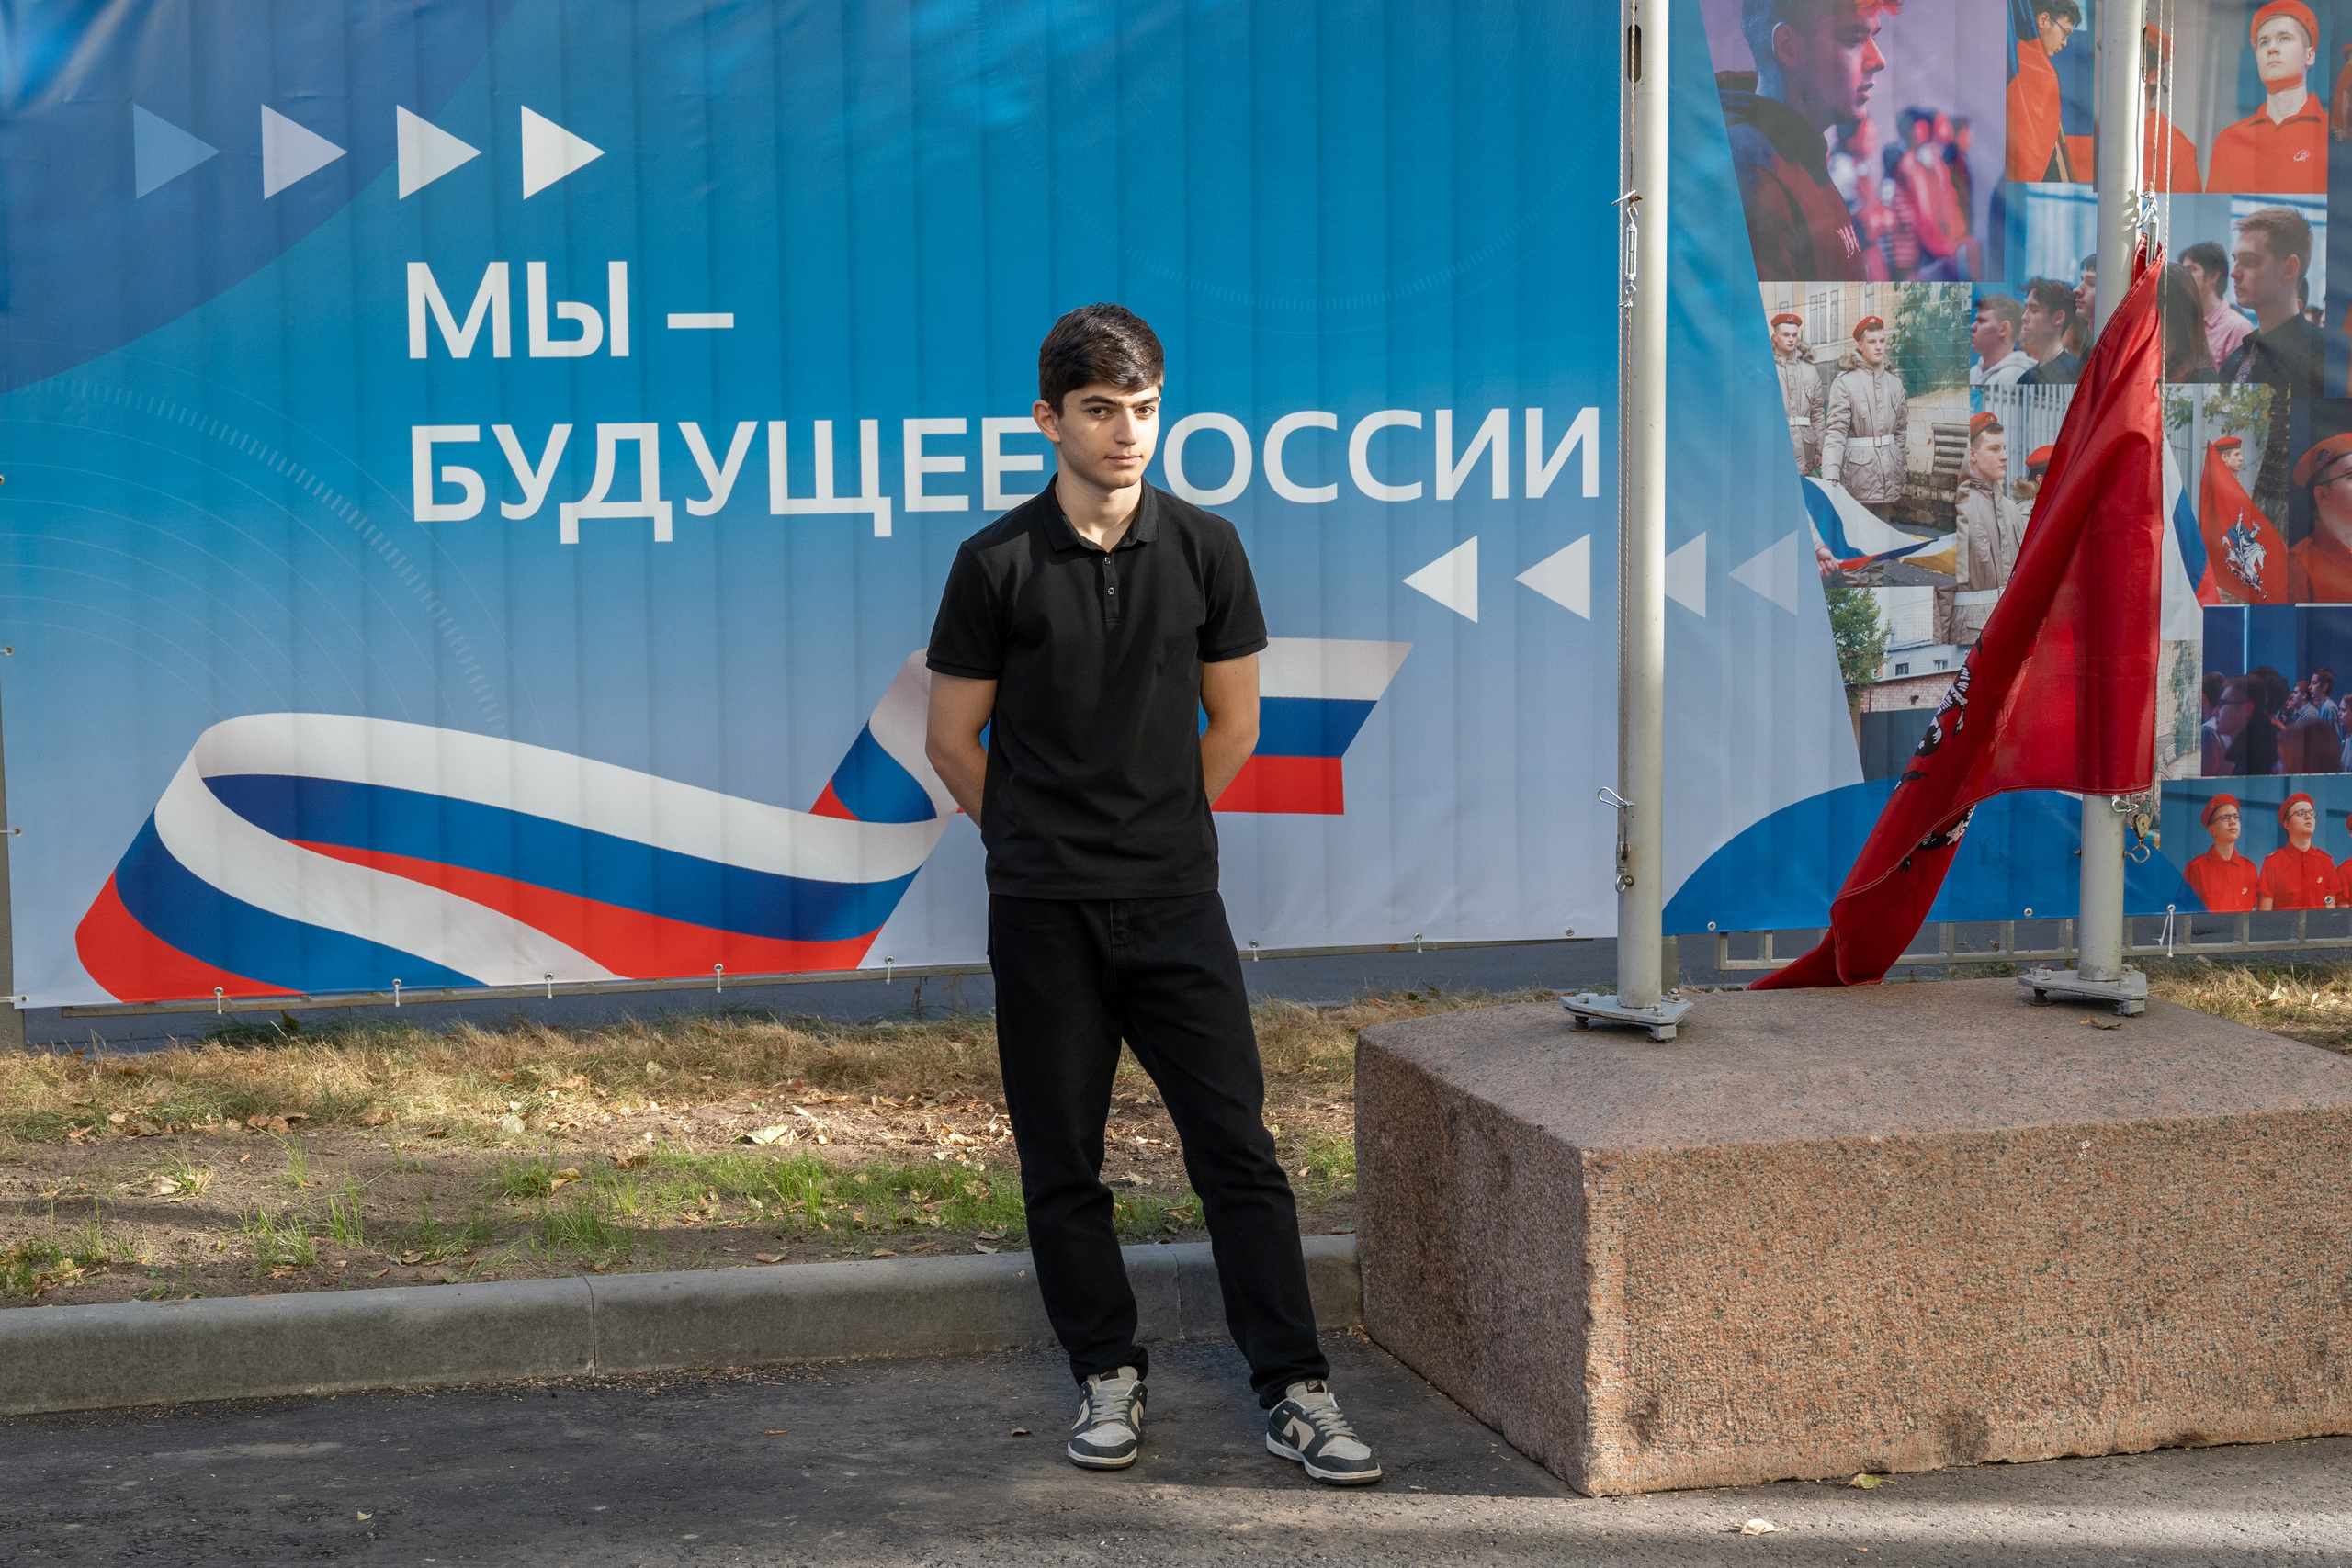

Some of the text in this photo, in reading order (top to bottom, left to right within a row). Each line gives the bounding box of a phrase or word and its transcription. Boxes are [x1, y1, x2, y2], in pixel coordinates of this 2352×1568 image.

[406, 260, 630, 360] МЫ
[411, 406, 1600, 545] БУДУЩЕЕ ОССИИ
